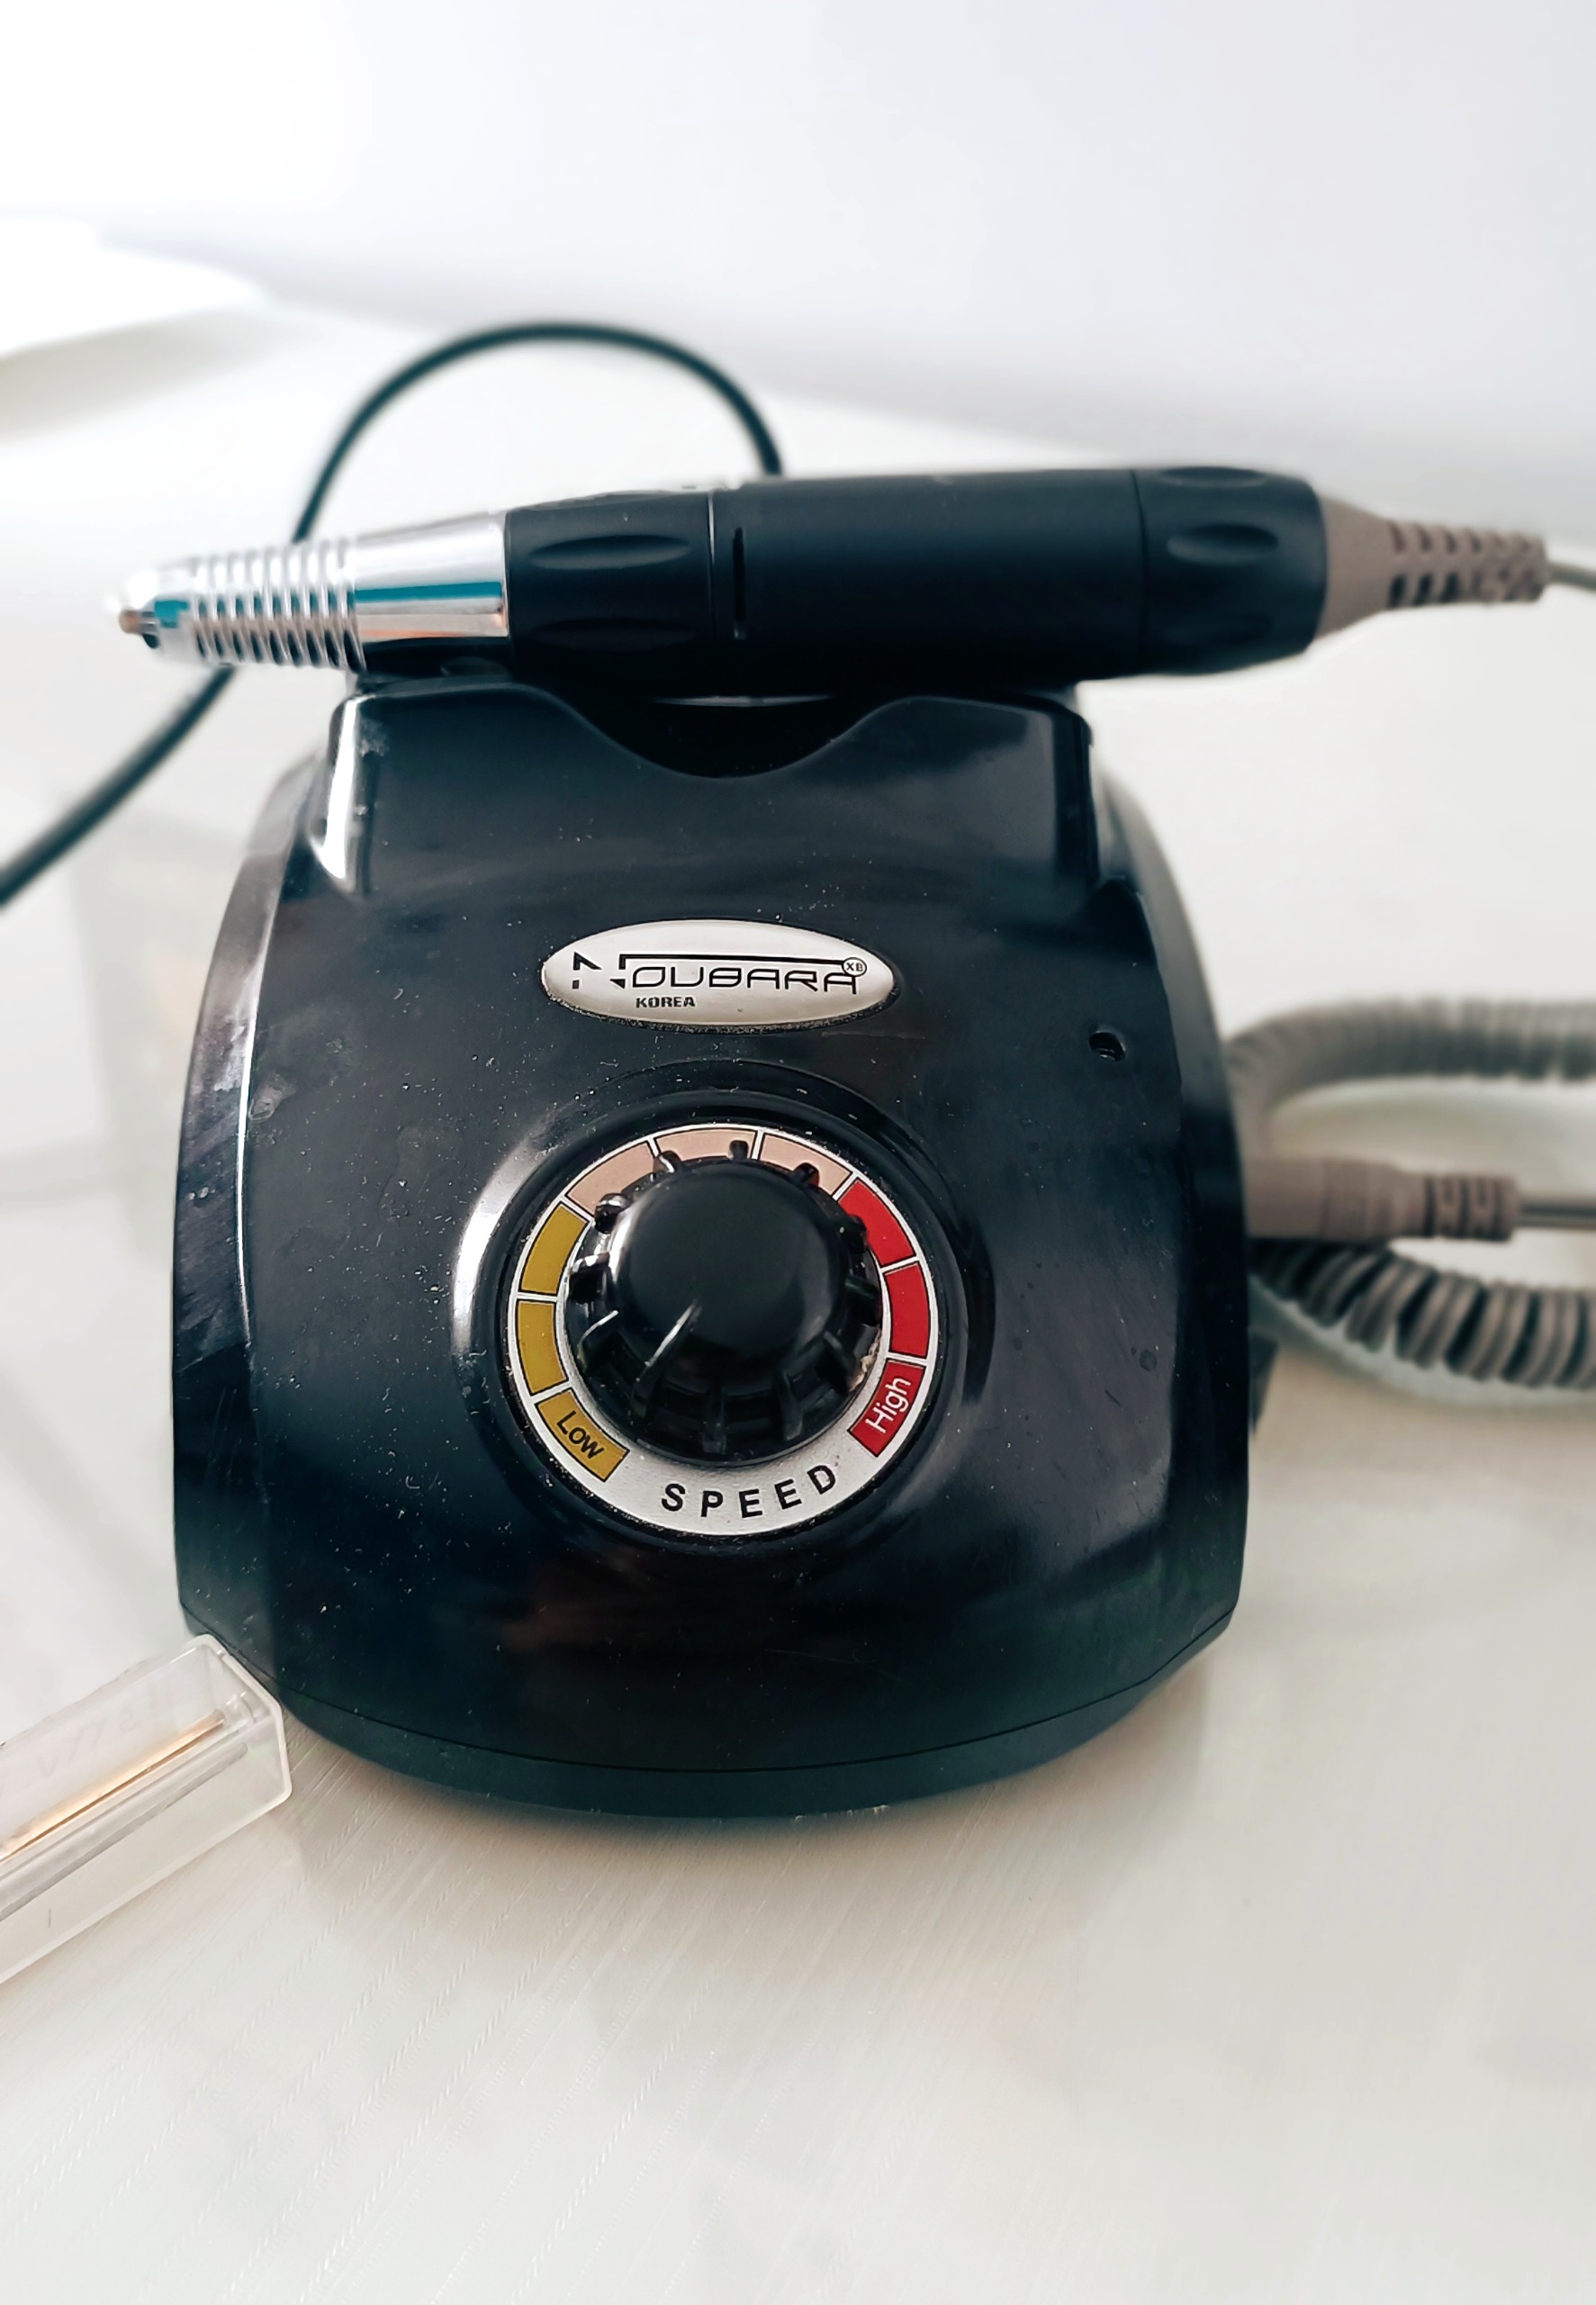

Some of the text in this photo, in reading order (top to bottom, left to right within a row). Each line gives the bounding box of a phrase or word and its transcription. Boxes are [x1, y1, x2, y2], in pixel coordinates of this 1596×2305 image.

[573, 952, 858, 995] NOUBARA
[636, 996, 696, 1008] KOREA
[865, 1376, 912, 1433] High
[661, 1464, 837, 1519] SPEED
